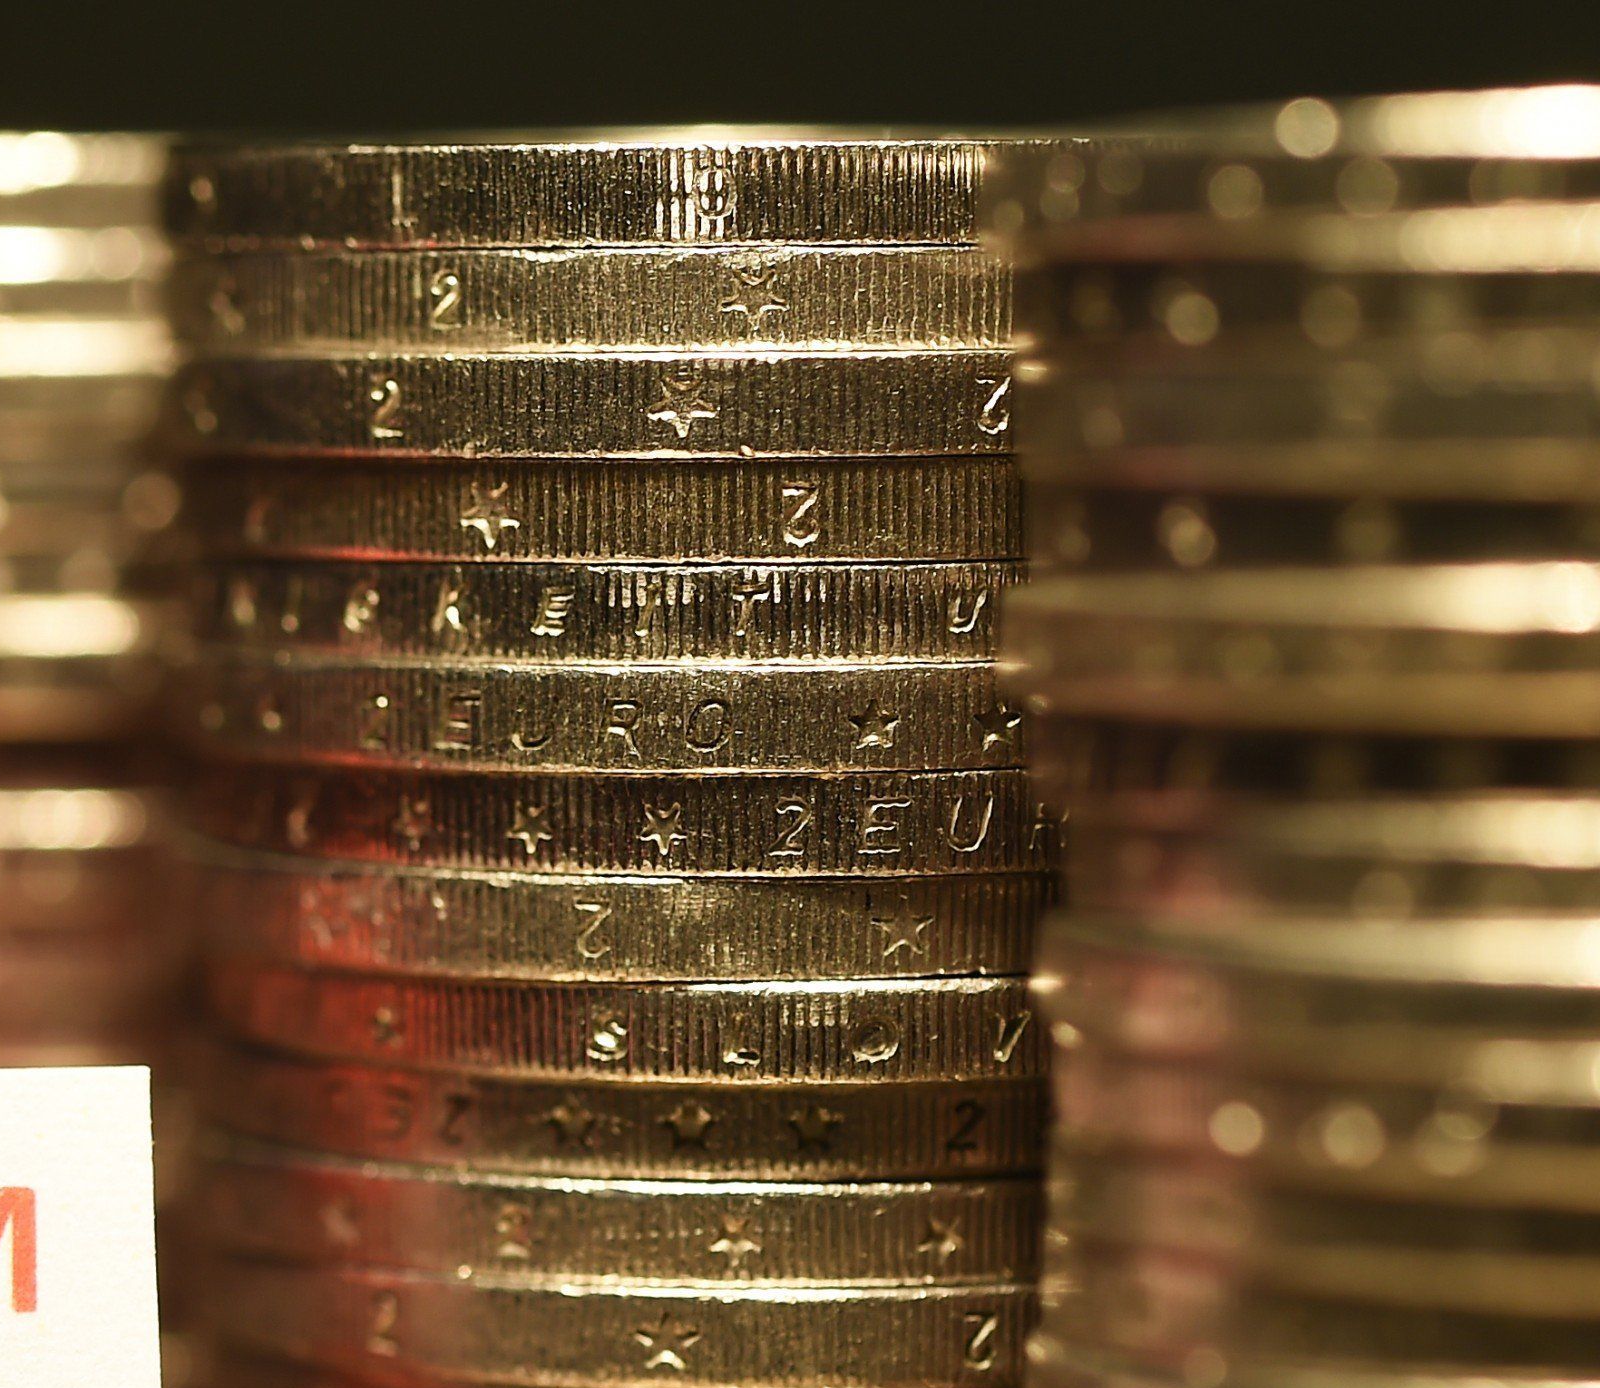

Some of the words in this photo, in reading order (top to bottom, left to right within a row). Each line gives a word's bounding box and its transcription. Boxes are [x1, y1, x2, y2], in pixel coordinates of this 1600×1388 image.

[431, 272, 462, 329] 2
[782, 482, 821, 548] 2
[572, 896, 614, 960] 2
[963, 1311, 998, 1372] 2
